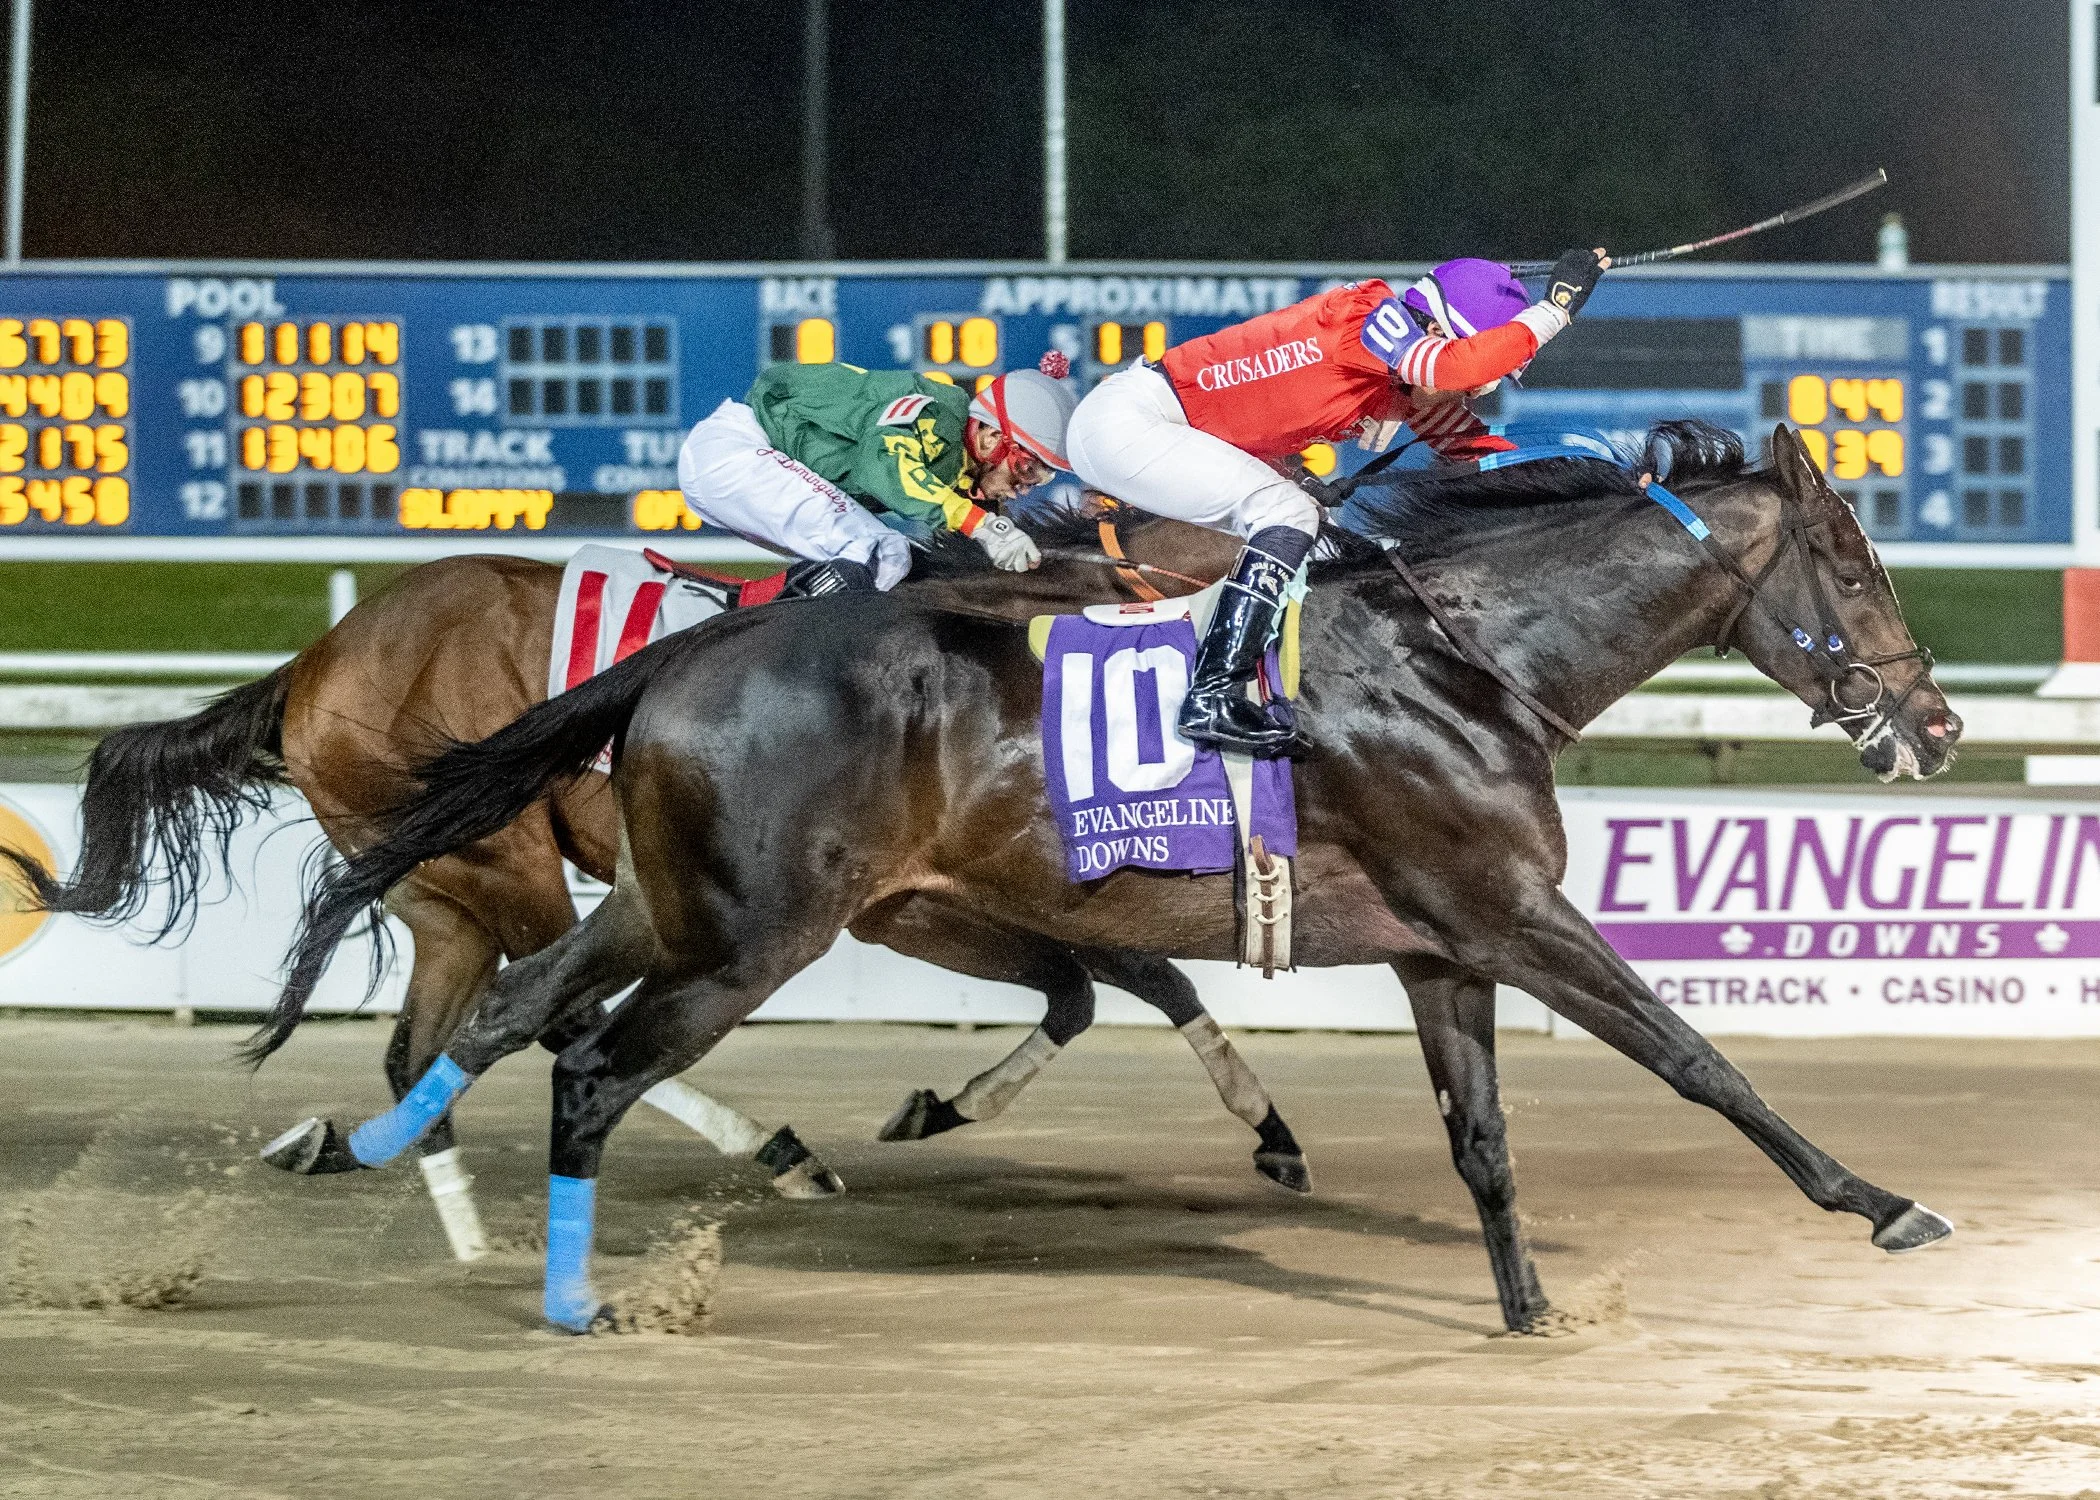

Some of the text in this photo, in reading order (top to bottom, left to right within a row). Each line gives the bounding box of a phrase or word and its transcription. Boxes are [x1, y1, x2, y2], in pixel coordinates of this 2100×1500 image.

[167, 281, 284, 317] POOL
[197, 325, 227, 364] 9
[242, 322, 399, 365] 11114
[452, 325, 498, 364] 13
[888, 325, 912, 362] 1
[931, 318, 998, 367] 10
[1366, 304, 1410, 353] 10
[1921, 327, 1949, 365] 1
[1197, 336, 1344, 392] CRUSADERS
[180, 380, 227, 418] 10
[242, 372, 399, 421] 12307
[451, 379, 498, 417] 14
[1924, 380, 1952, 420] 2
[186, 431, 227, 469] 11
[242, 424, 399, 473] 13406
[420, 432, 553, 463] TRACK
[1926, 434, 1953, 475] 3
[181, 481, 227, 519] 12
[1921, 487, 1954, 527] 4
[1061, 645, 1195, 802] 10
[1073, 799, 1235, 837] EVANGELINE
[1077, 835, 1170, 873] DOWNS
[1882, 976, 2025, 1004] CASINO
